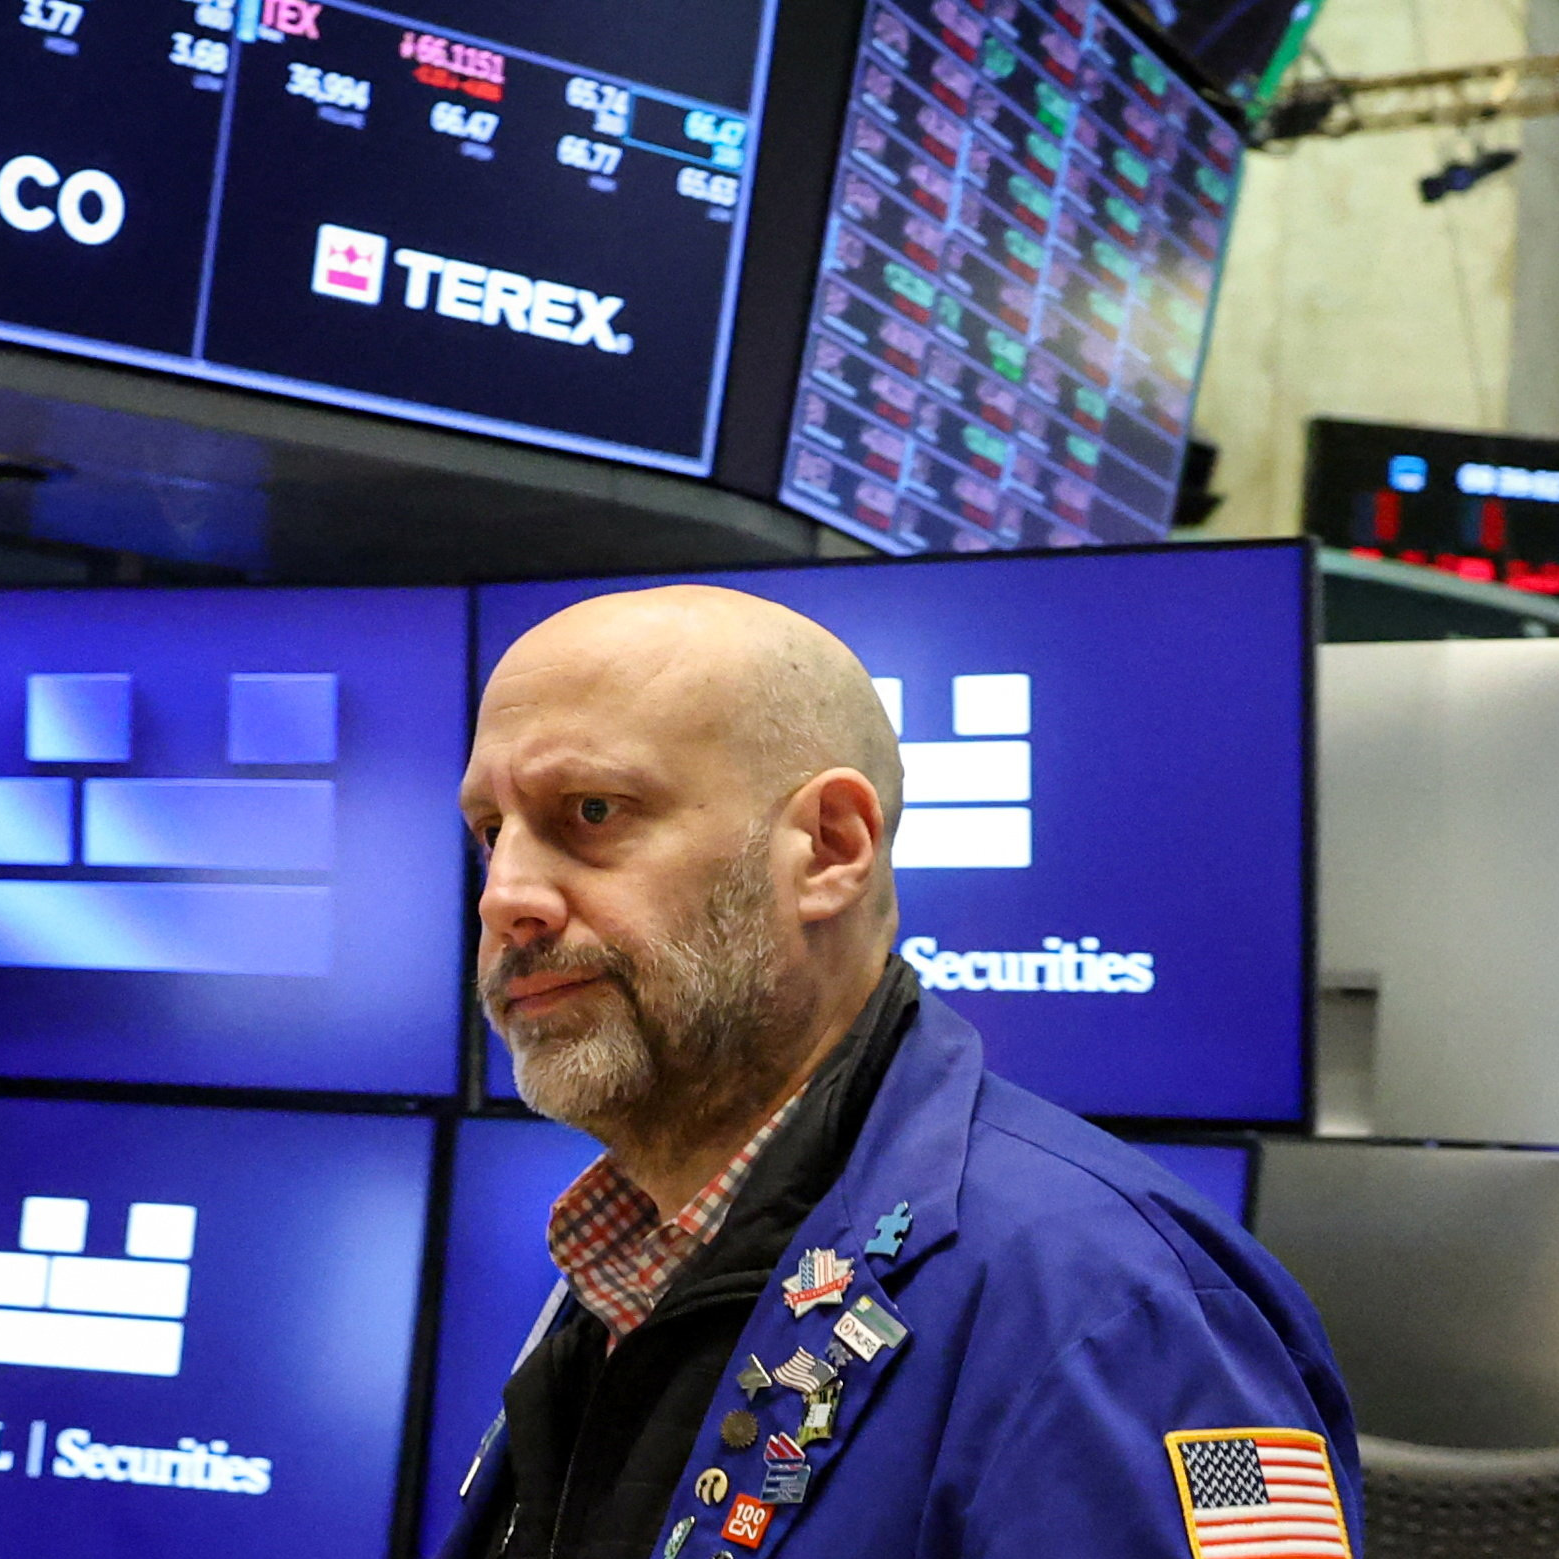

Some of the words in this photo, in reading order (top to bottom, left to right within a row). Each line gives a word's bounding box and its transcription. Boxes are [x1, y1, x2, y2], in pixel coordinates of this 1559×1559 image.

[899, 936, 1156, 994] Securities
[53, 1427, 272, 1495] Securities
[735, 1502, 766, 1526] 100
